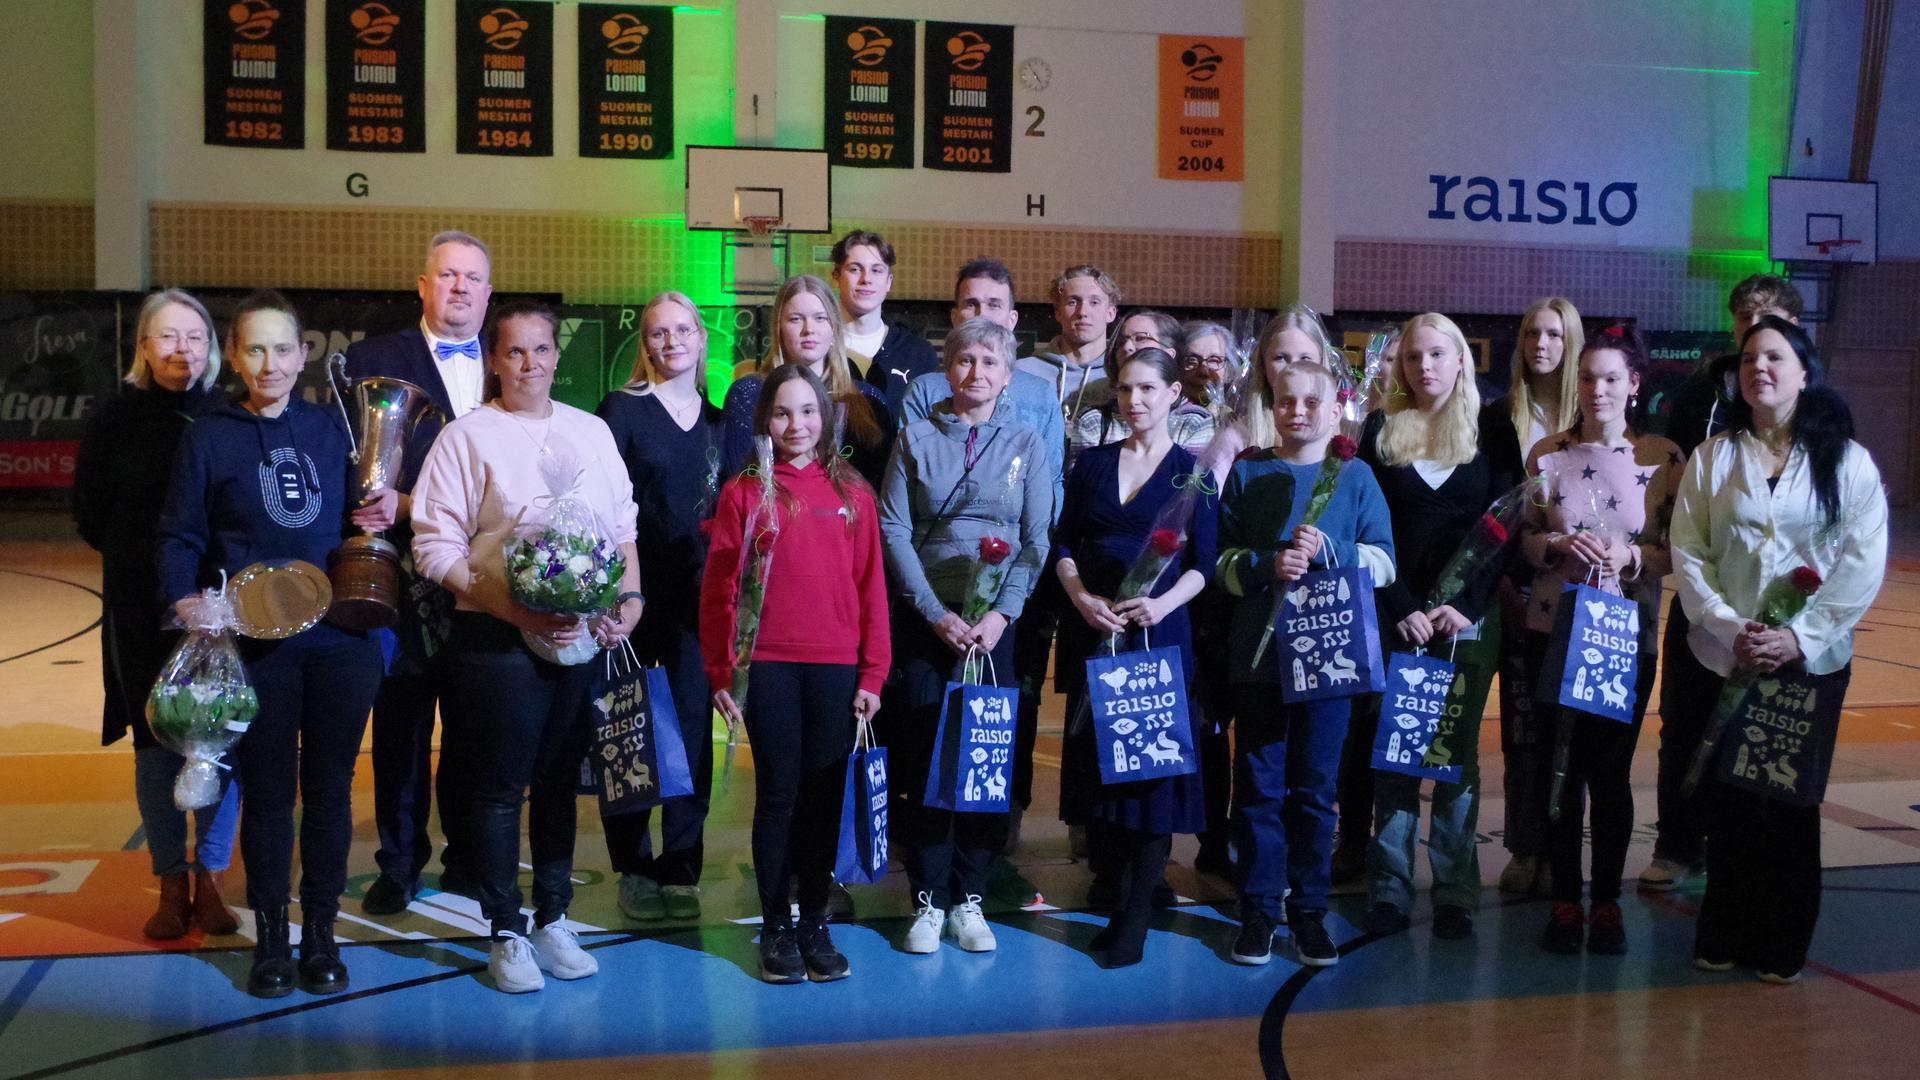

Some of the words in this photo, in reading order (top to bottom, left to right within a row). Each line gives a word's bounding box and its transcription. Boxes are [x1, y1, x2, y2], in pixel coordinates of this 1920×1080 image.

[226, 88, 282, 100] SUOMEN
[348, 93, 403, 105] SUOMEN
[226, 101, 282, 114] MESTARI
[348, 106, 403, 118] MESTARI
[478, 98, 532, 109] SUOMEN
[600, 102, 652, 113] SUOMEN
[478, 111, 532, 123] MESTARI
[600, 115, 652, 126] MESTARI
[844, 112, 894, 123] SUOMEN
[943, 116, 993, 127] SUOMEN
[1024, 105, 1046, 137] 2
[226, 120, 282, 140] 1982
[348, 125, 404, 144] 1983
[478, 129, 532, 148] 1984
[844, 124, 894, 136] MESTARI
[943, 128, 993, 140] MESTARI
[1179, 126, 1224, 136] SUOMEN
[600, 133, 653, 150] 1990
[1191, 139, 1213, 149] CUP
[844, 142, 894, 160] 1997
[943, 146, 993, 164] 2001
[1177, 155, 1225, 172] 2004
[346, 173, 369, 198] G
[1026, 193, 1045, 217] H
[1428, 174, 1638, 226] raisio
[281, 473, 301, 499] FIN
[1286, 609, 1354, 634] raisio
[1582, 627, 1639, 655] raisio
[1104, 691, 1176, 716] raisio
[1394, 693, 1464, 718] raisio
[596, 712, 646, 742] raisio
[1744, 703, 1813, 736] raisio
[969, 728, 1012, 745] raisio
